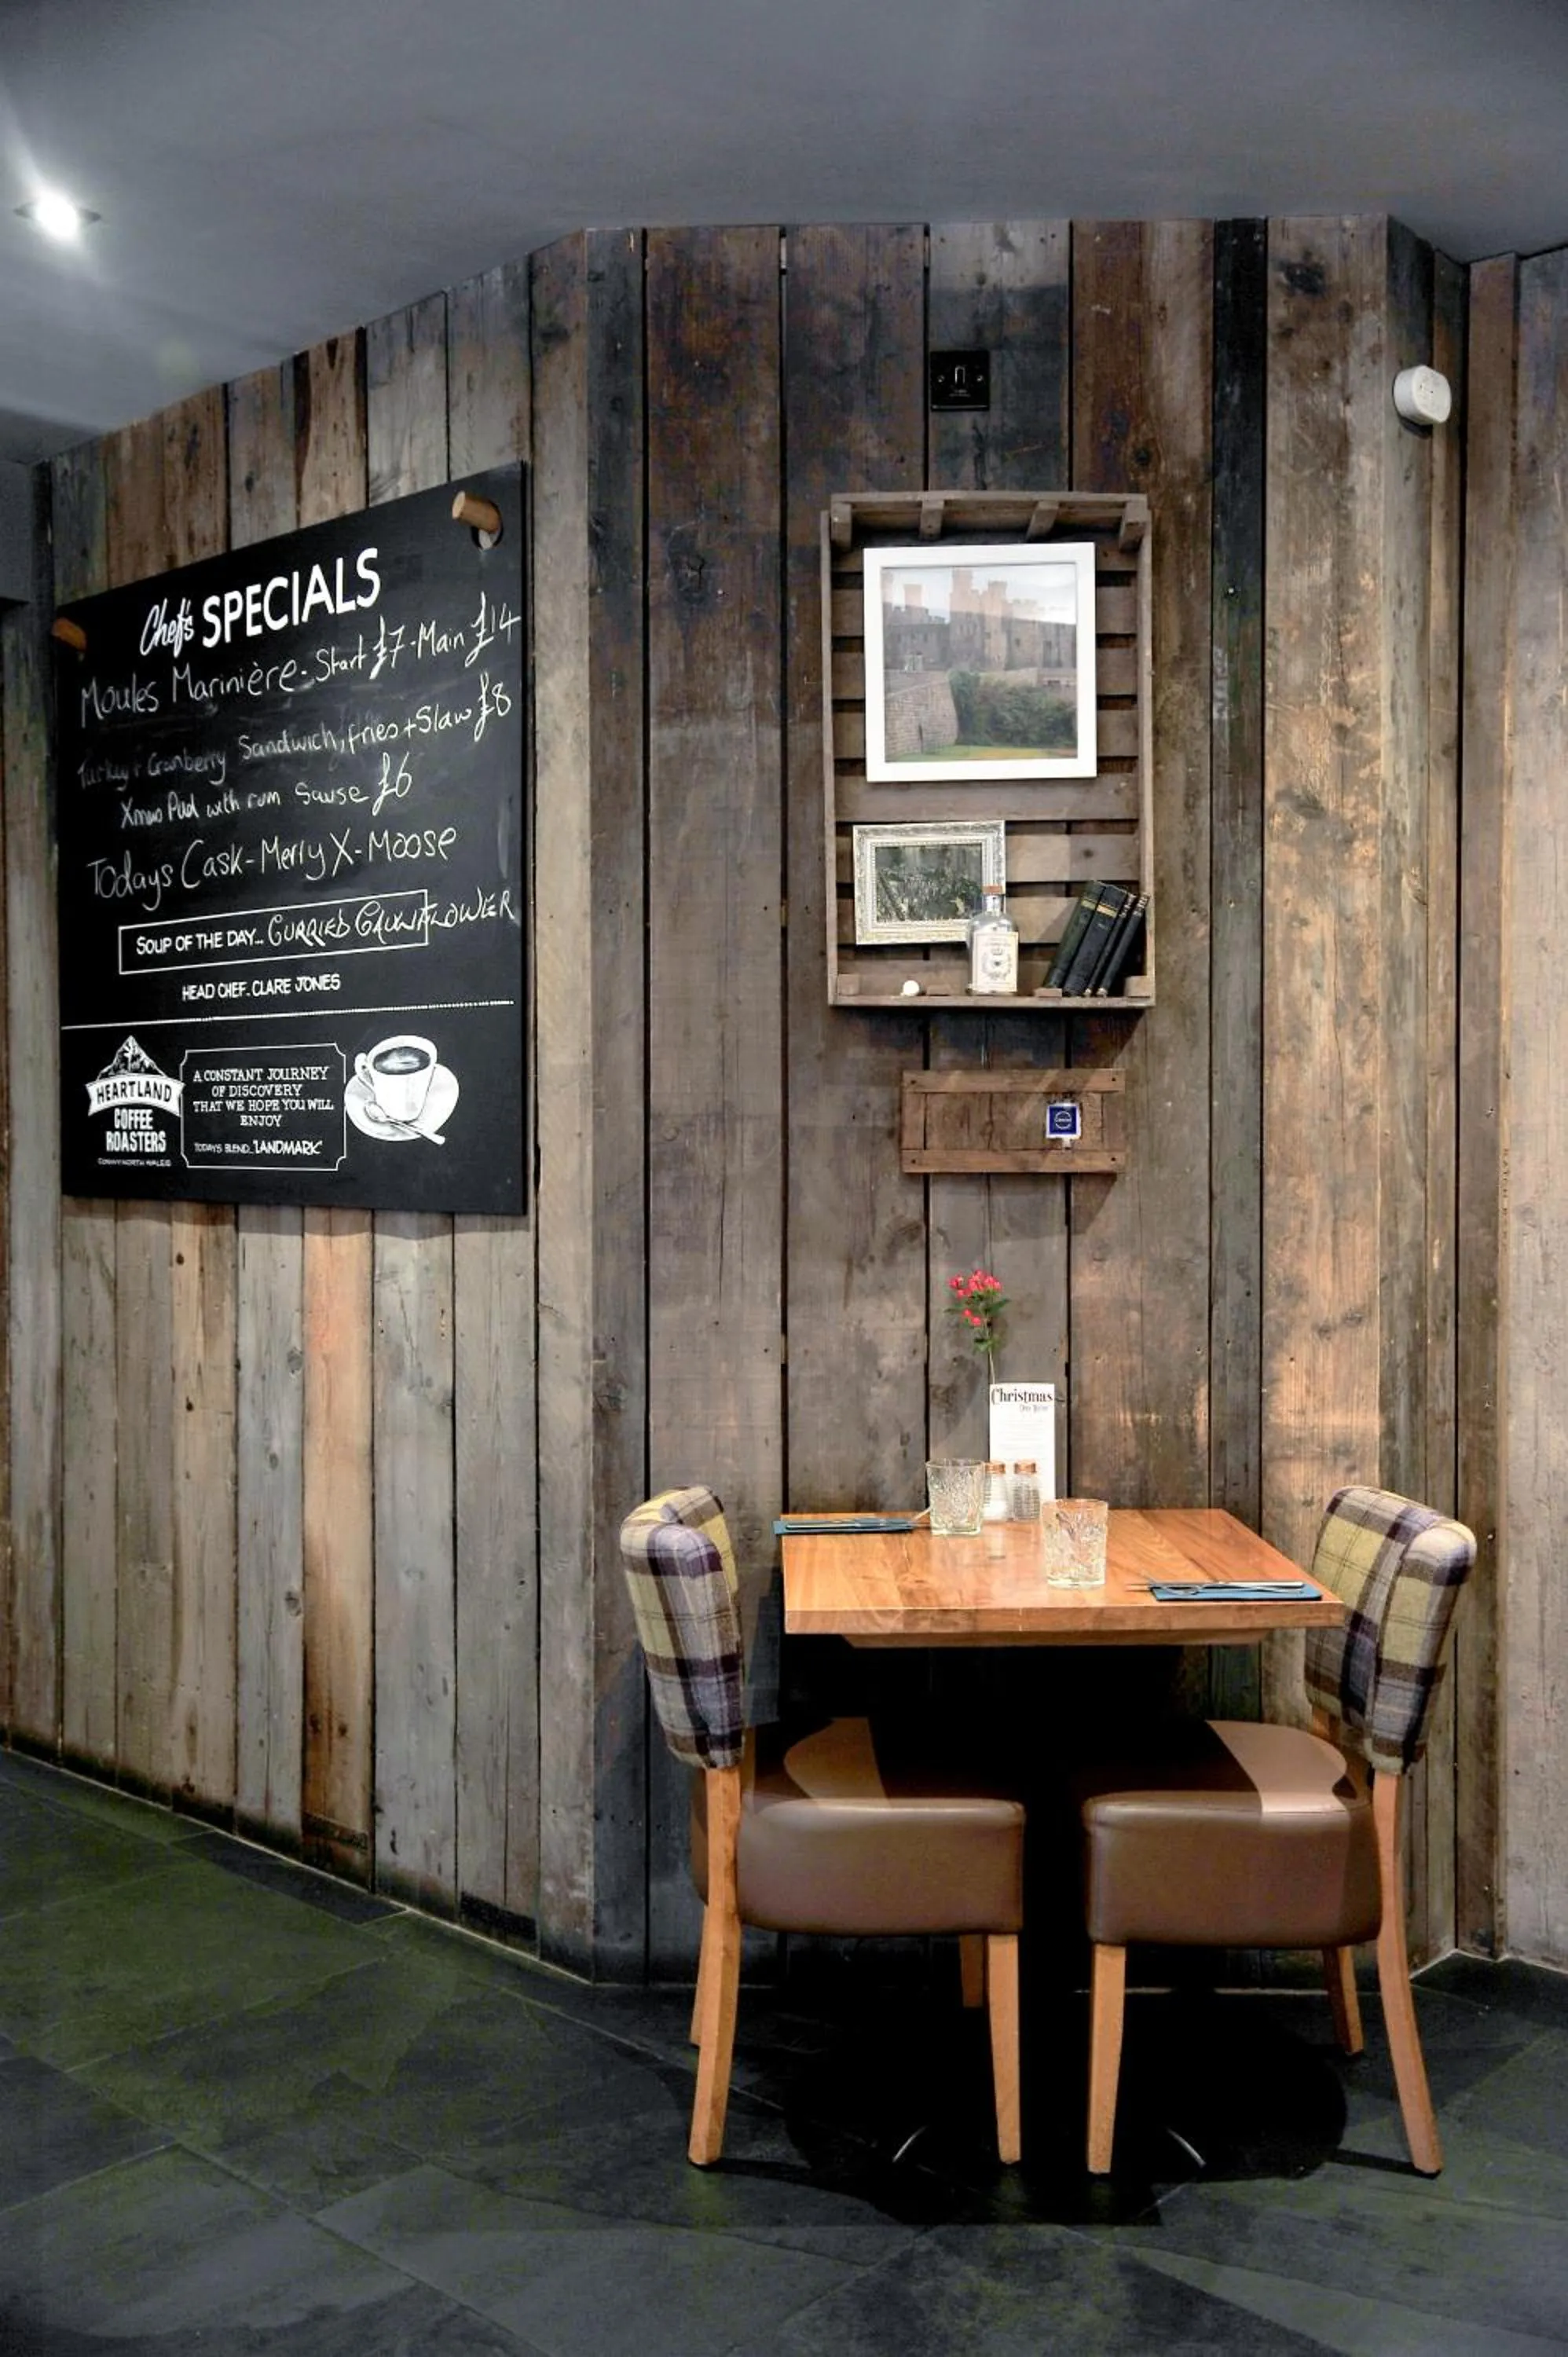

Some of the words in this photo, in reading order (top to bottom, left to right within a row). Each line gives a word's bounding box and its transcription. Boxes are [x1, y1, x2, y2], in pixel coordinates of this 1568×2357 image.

[139, 597, 195, 658] Chef's
[202, 547, 382, 649] SPECIALS
[81, 671, 159, 729] Moules
[173, 658, 297, 704] Marinière
[315, 634, 367, 682] Start
[369, 614, 405, 680] £7
[418, 619, 466, 659] Main
[464, 591, 522, 669] £14
[148, 747, 226, 786] Cranberry
[348, 723, 399, 756] fries
[416, 704, 472, 735] Slaw
[473, 672, 511, 743] £8
[167, 790, 200, 823] Pud
[207, 787, 240, 819] with
[247, 790, 281, 809] rum
[295, 781, 370, 806] Sause
[372, 751, 413, 817] £6
[86, 849, 174, 911] Todays
[181, 839, 243, 889] Cask
[262, 835, 326, 882] Merry
[136, 935, 172, 955] SOUP
[175, 934, 193, 952] OF
[196, 932, 224, 950] THE
[268, 908, 351, 948] CURRIED
[181, 983, 216, 1002] HEAD
[251, 977, 291, 998] CLARE
[294, 973, 342, 993] JONES
[192, 1069, 203, 1083] A
[203, 1067, 264, 1082] CONSTANT
[266, 1065, 330, 1081] JOURNEY
[96, 1080, 172, 1105] HEARTLAND
[211, 1085, 226, 1098] OF
[229, 1083, 303, 1097] DISCOVERY
[192, 1101, 223, 1113] THAT
[225, 1099, 245, 1112] WE
[248, 1099, 280, 1112] HOPE
[280, 1098, 306, 1111] YOU
[307, 1098, 335, 1110] WILL
[114, 1107, 153, 1130] COFFEE
[240, 1114, 282, 1127] ENJOY
[106, 1130, 167, 1153] ROASTERS
[991, 1387, 1053, 1406] Christmas
